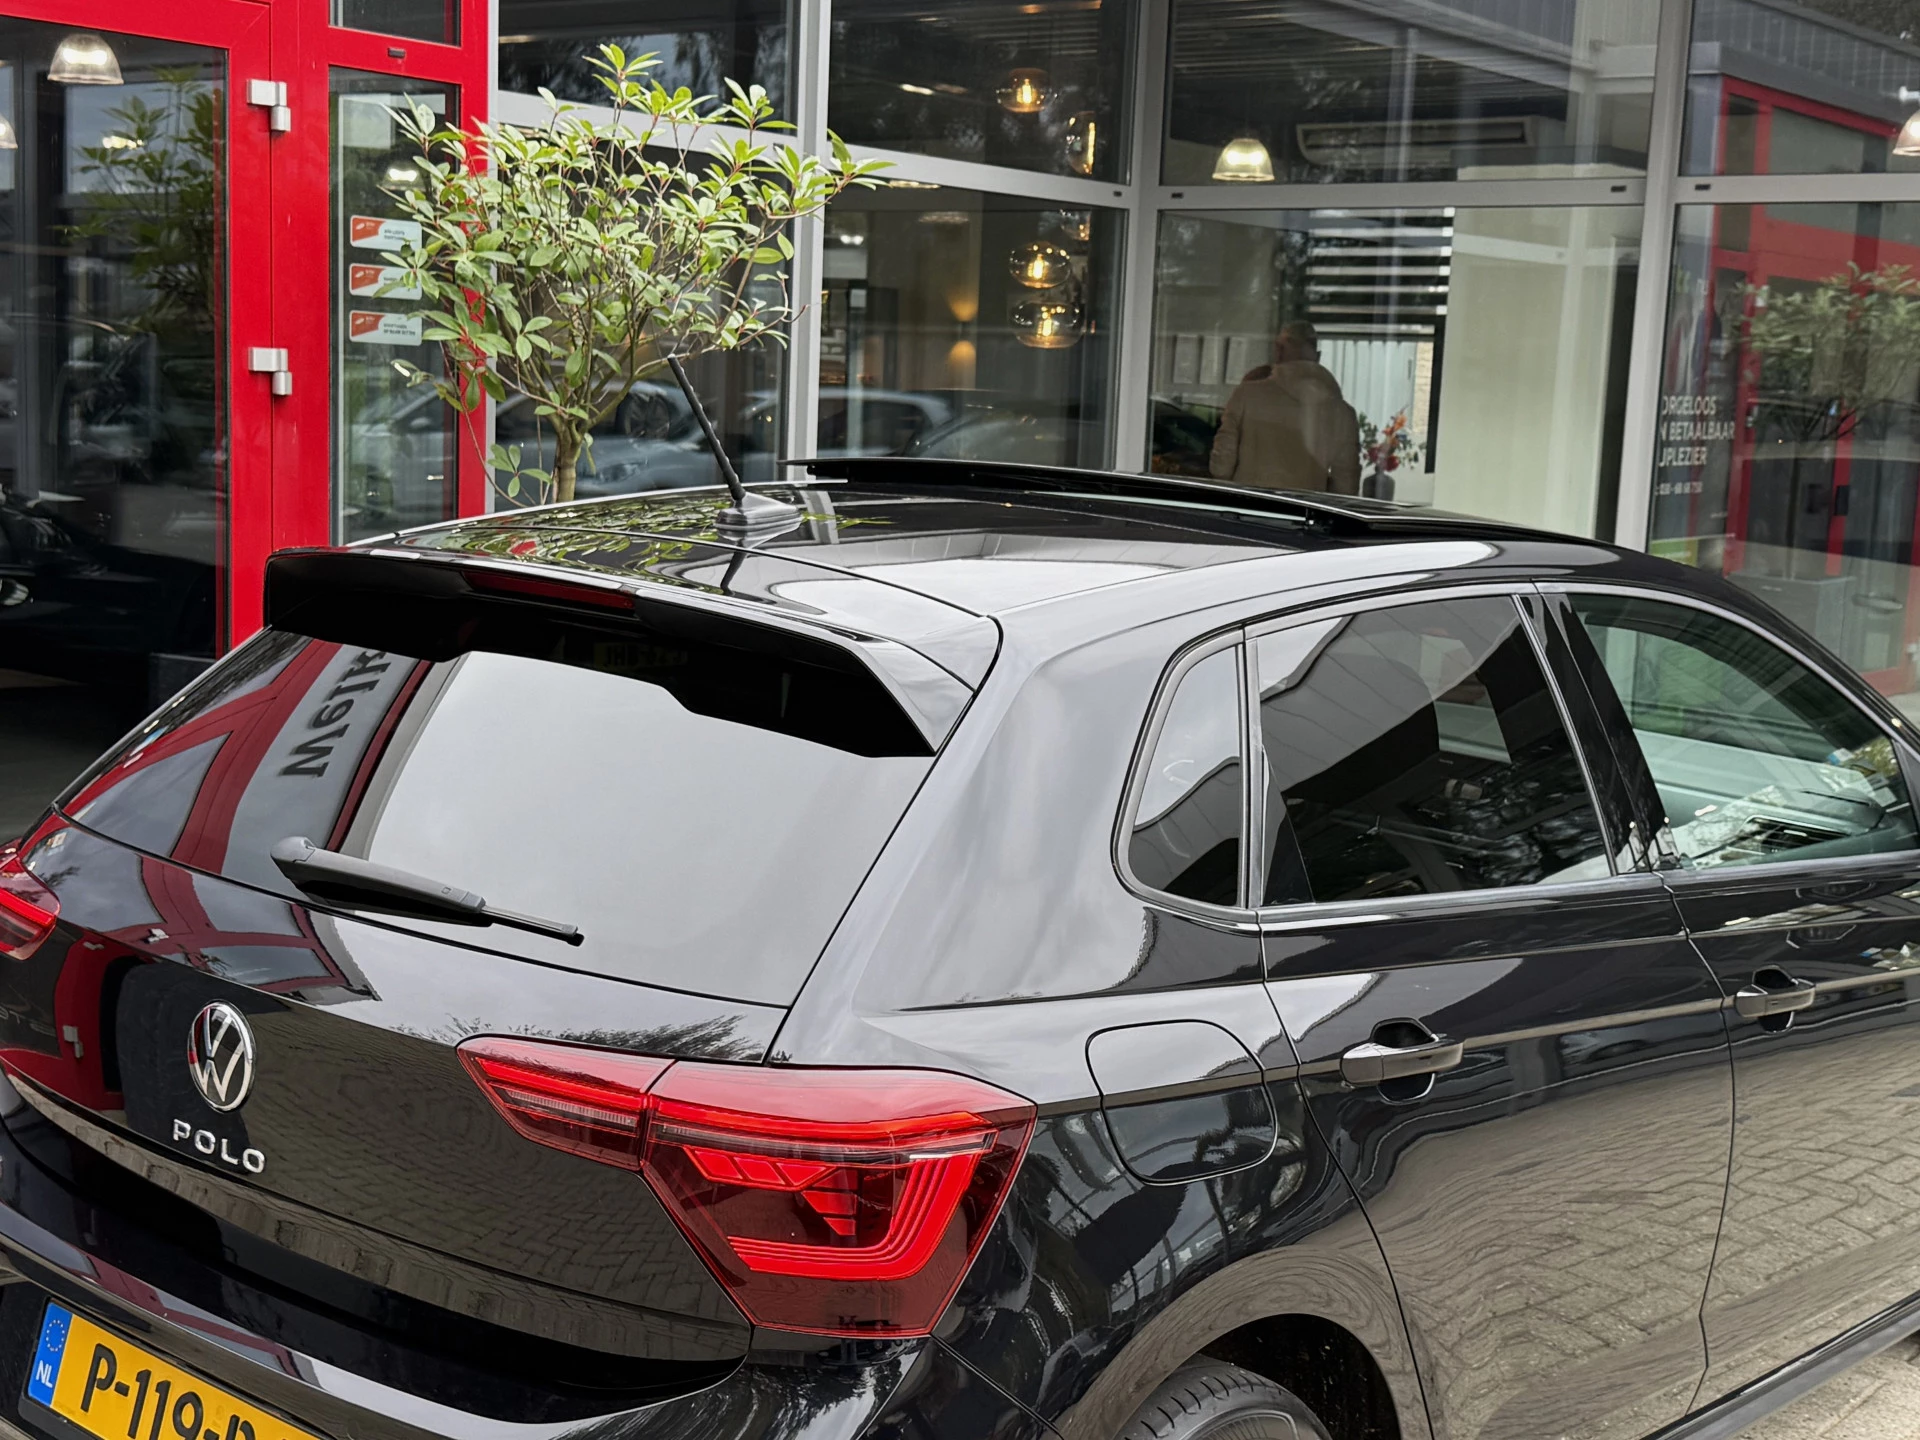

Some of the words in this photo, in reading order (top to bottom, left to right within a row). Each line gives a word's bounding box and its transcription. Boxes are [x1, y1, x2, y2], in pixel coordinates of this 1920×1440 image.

[1669, 420, 1735, 440] BETAALBAAR
[172, 1118, 266, 1174] POLO
[35, 1359, 54, 1389] NL
